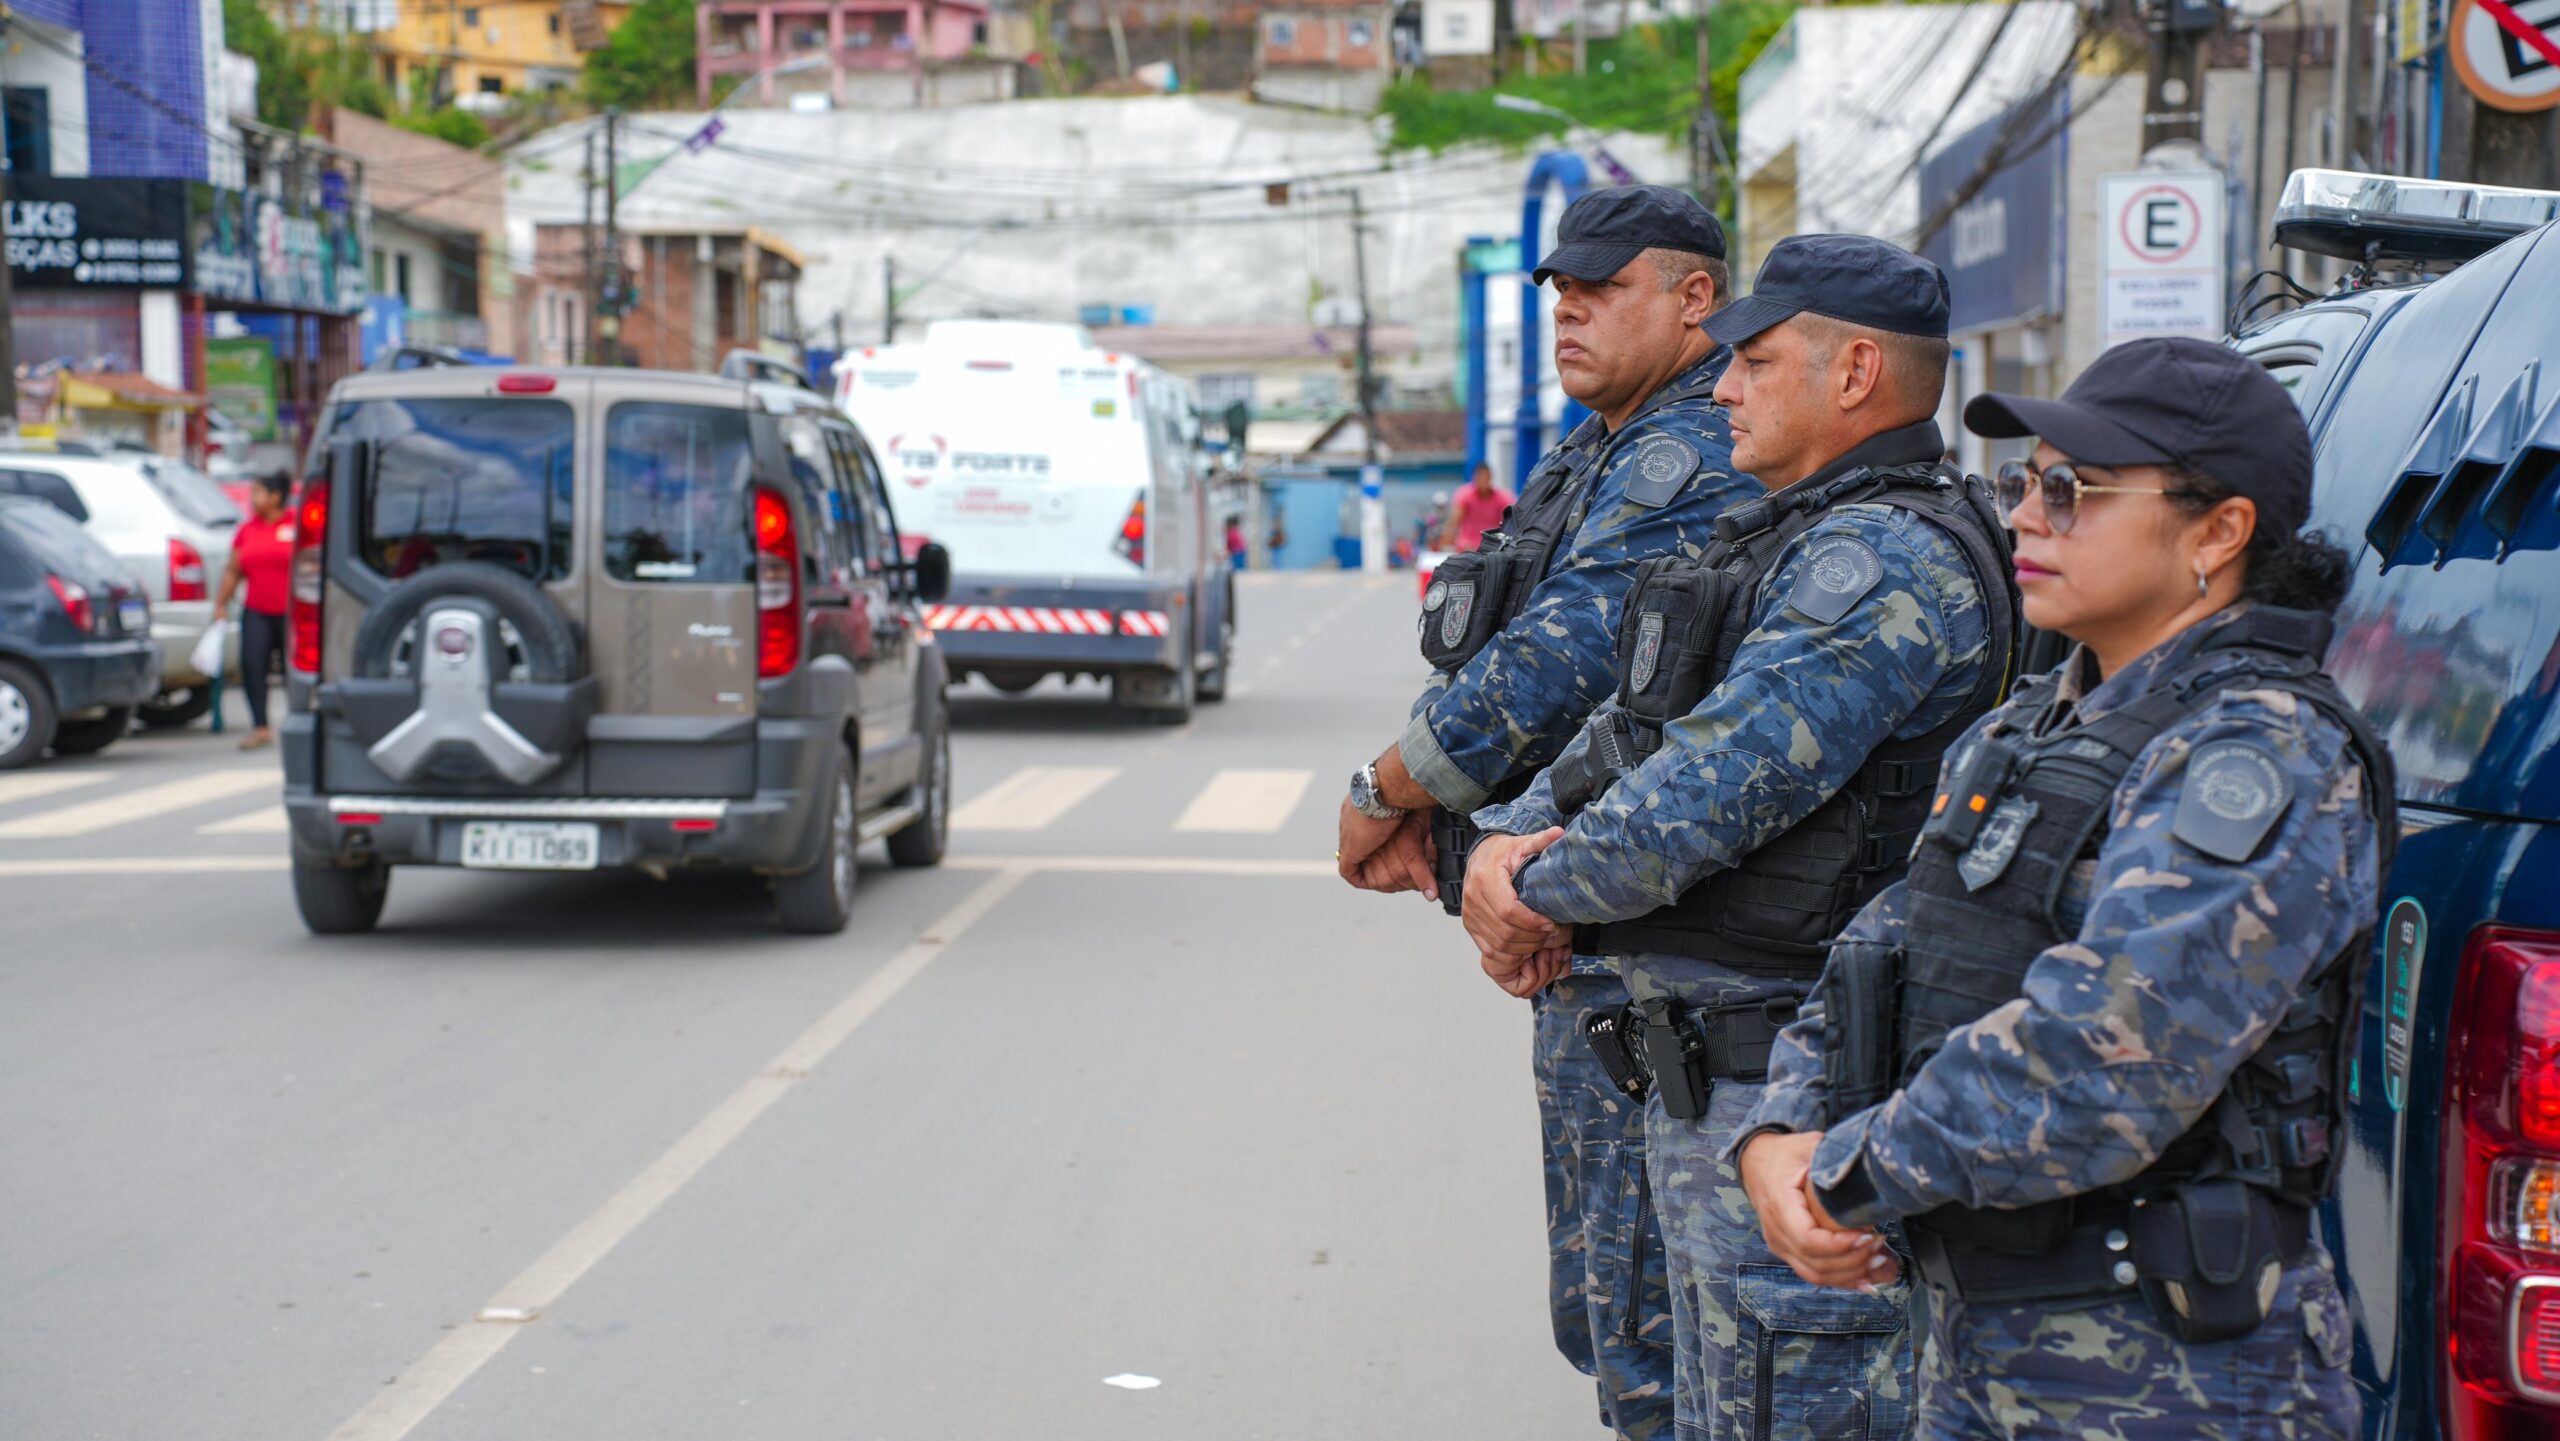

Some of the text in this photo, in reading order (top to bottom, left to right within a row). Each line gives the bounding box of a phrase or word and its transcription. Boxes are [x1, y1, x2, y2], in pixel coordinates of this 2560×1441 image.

[2145, 201, 2179, 248] E
[952, 452, 1050, 472] FORTE
[1636, 439, 1692, 475] GUARDA CIVIL MUNICIPAL
[1809, 541, 1874, 587] GUARDA CIVIL MUNICIPAL
